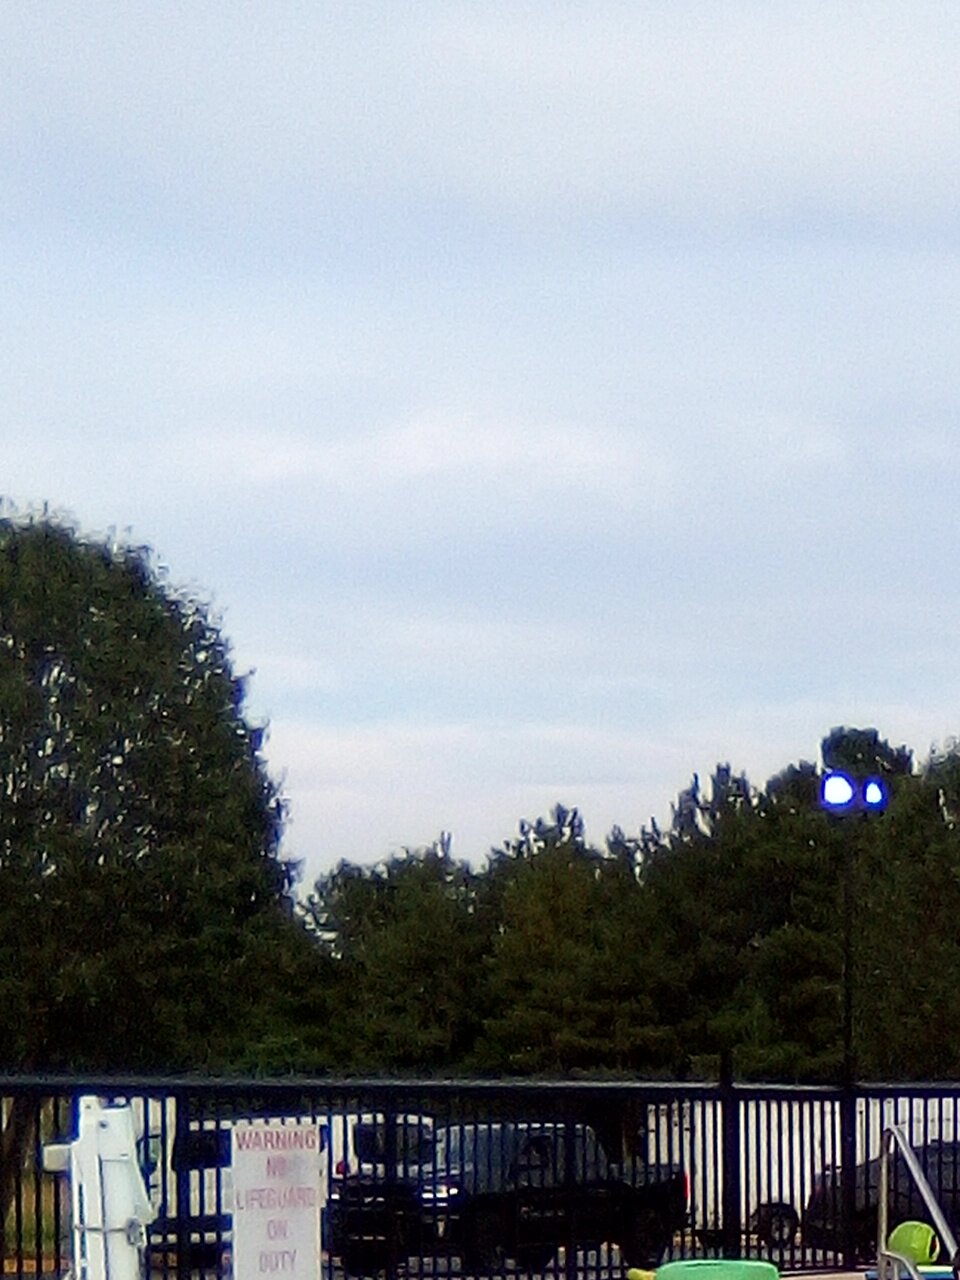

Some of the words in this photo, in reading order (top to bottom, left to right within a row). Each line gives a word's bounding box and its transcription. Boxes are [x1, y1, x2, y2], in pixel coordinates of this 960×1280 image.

[235, 1129, 316, 1150] WARNING
[266, 1155, 288, 1177] NO
[235, 1187, 316, 1211] LIFEGUARD
[266, 1218, 288, 1241] ON
[258, 1250, 297, 1274] DUTY
